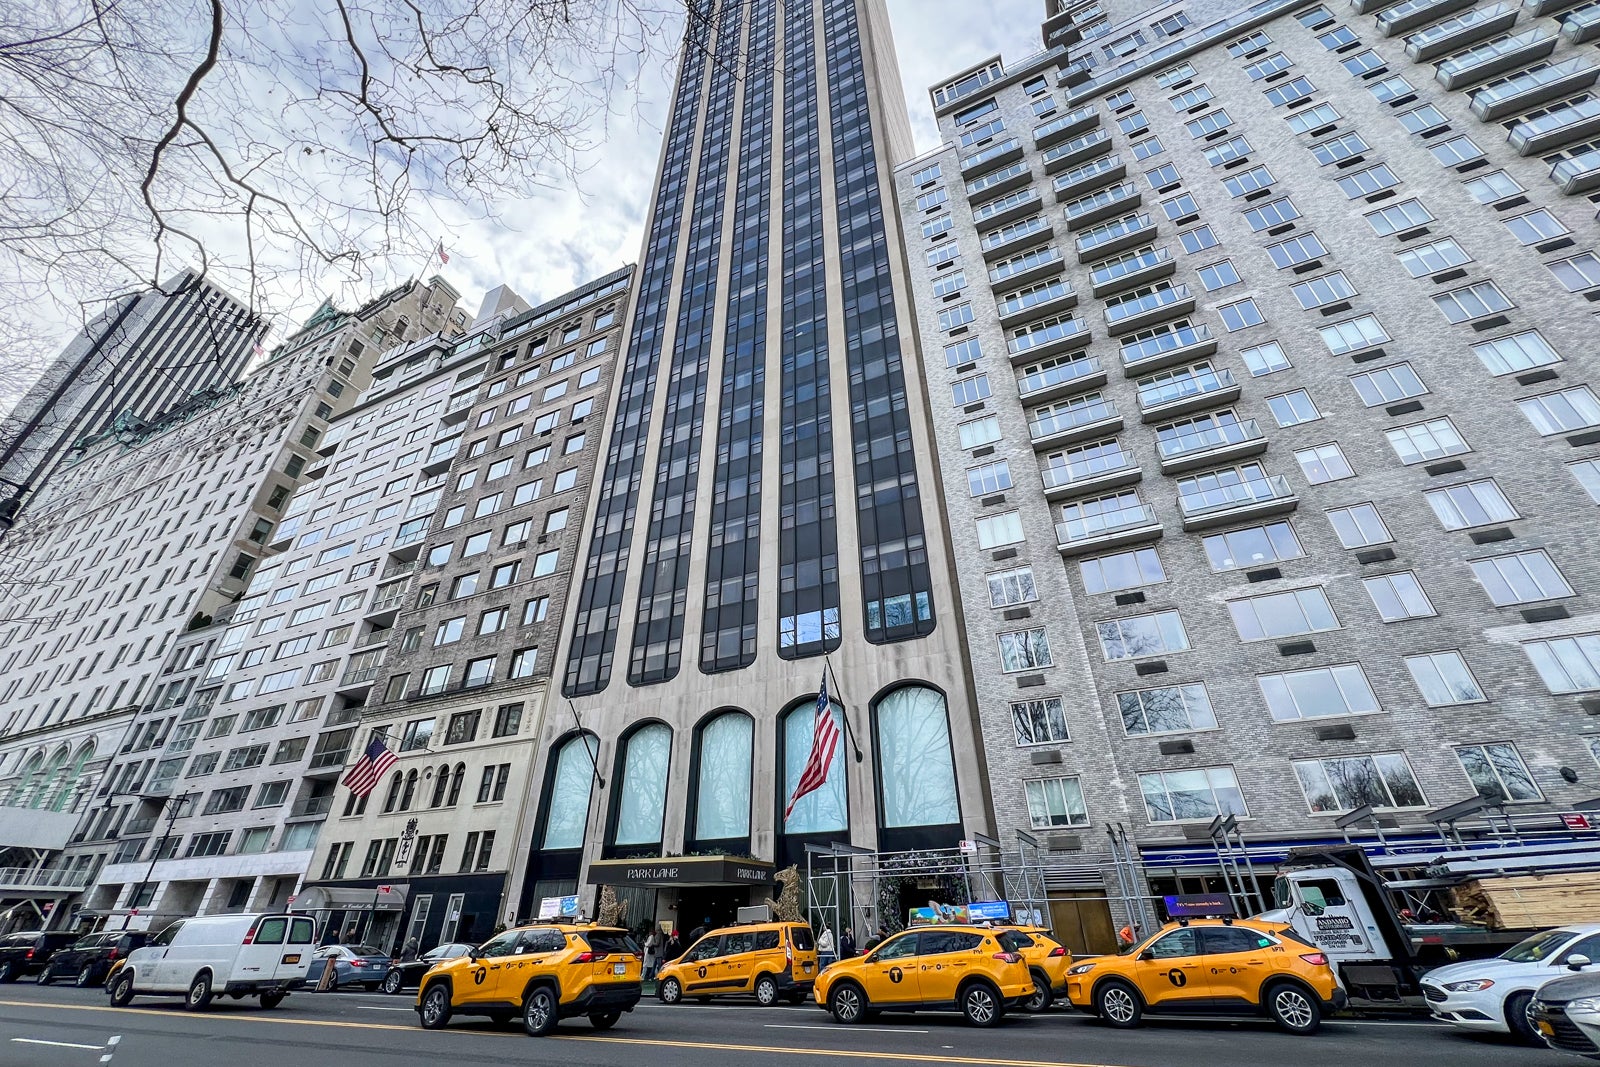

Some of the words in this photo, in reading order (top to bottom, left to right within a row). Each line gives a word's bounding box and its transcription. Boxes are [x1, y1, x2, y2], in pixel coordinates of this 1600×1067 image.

[627, 868, 651, 879] PARK
[653, 868, 679, 878] LANE
[737, 868, 750, 878] PARK
[751, 869, 766, 880] LANE
